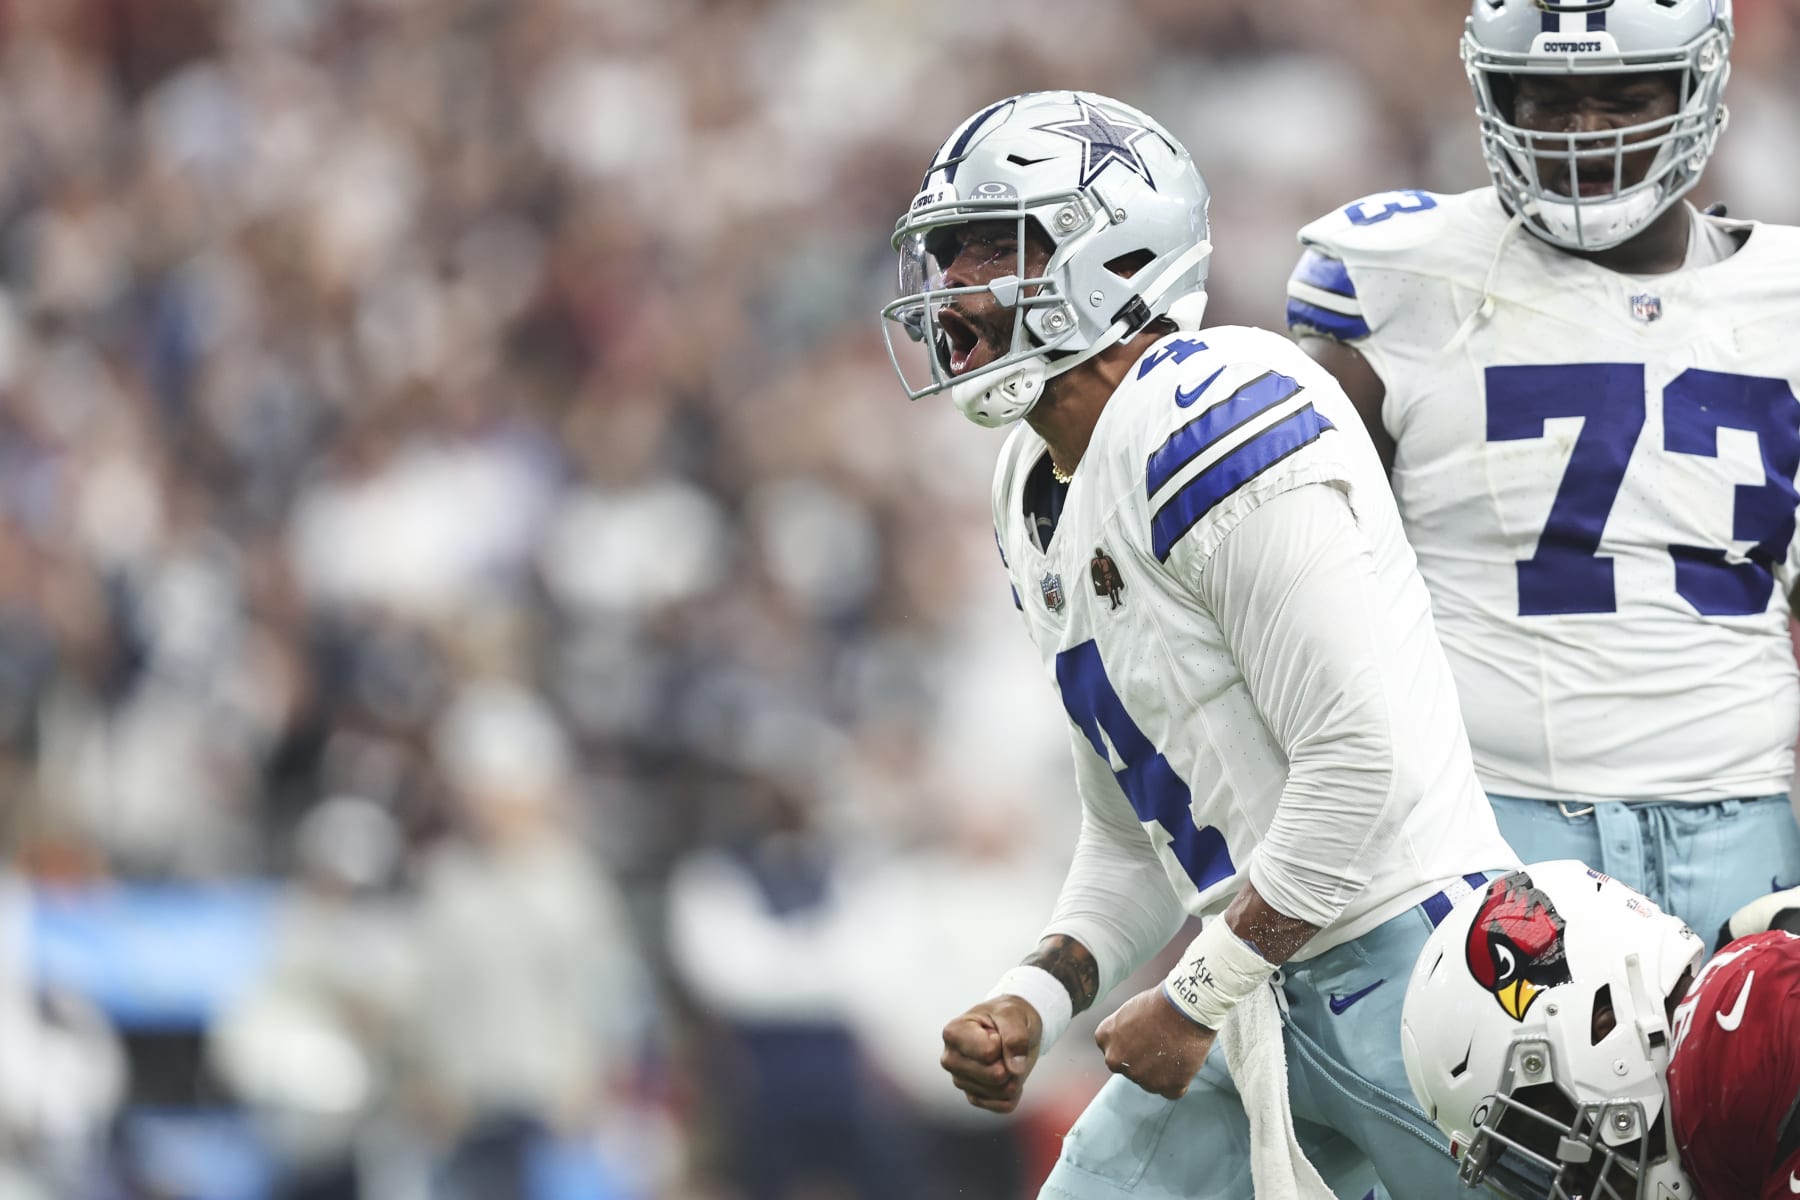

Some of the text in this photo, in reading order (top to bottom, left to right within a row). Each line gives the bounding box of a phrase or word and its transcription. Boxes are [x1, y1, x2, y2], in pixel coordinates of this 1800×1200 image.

[1543, 41, 1602, 53] COWBOYS
[1136, 338, 1209, 381] 4
[1484, 362, 1800, 616] 73
[1055, 637, 1236, 893] 4
